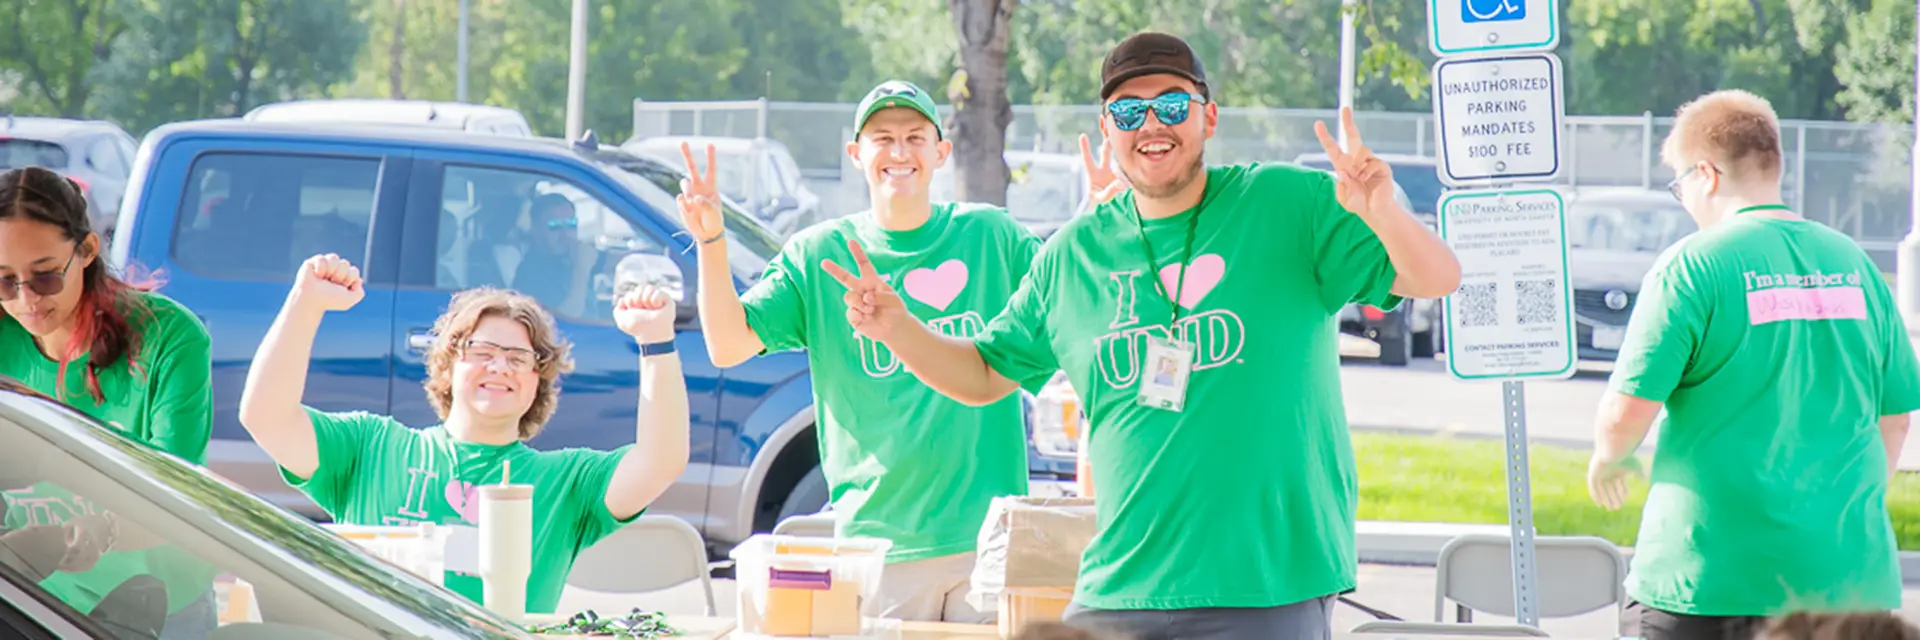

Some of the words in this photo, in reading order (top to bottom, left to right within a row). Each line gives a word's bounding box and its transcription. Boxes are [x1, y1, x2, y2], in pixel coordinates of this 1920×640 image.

[1444, 77, 1549, 95] UNAUTHORIZED
[1467, 100, 1527, 115] PARKING
[1462, 121, 1536, 136] MANDATES
[1468, 144, 1498, 158] $100
[1507, 142, 1531, 156] FEE
[1743, 270, 1773, 290] I'm
[1774, 274, 1784, 286] a
[1785, 269, 1844, 287] member
[1109, 270, 1142, 330] I
[1464, 343, 1495, 353] CONTACT
[1496, 341, 1526, 351] PARKING
[1527, 340, 1560, 350] SERVICES
[398, 467, 437, 519] I
